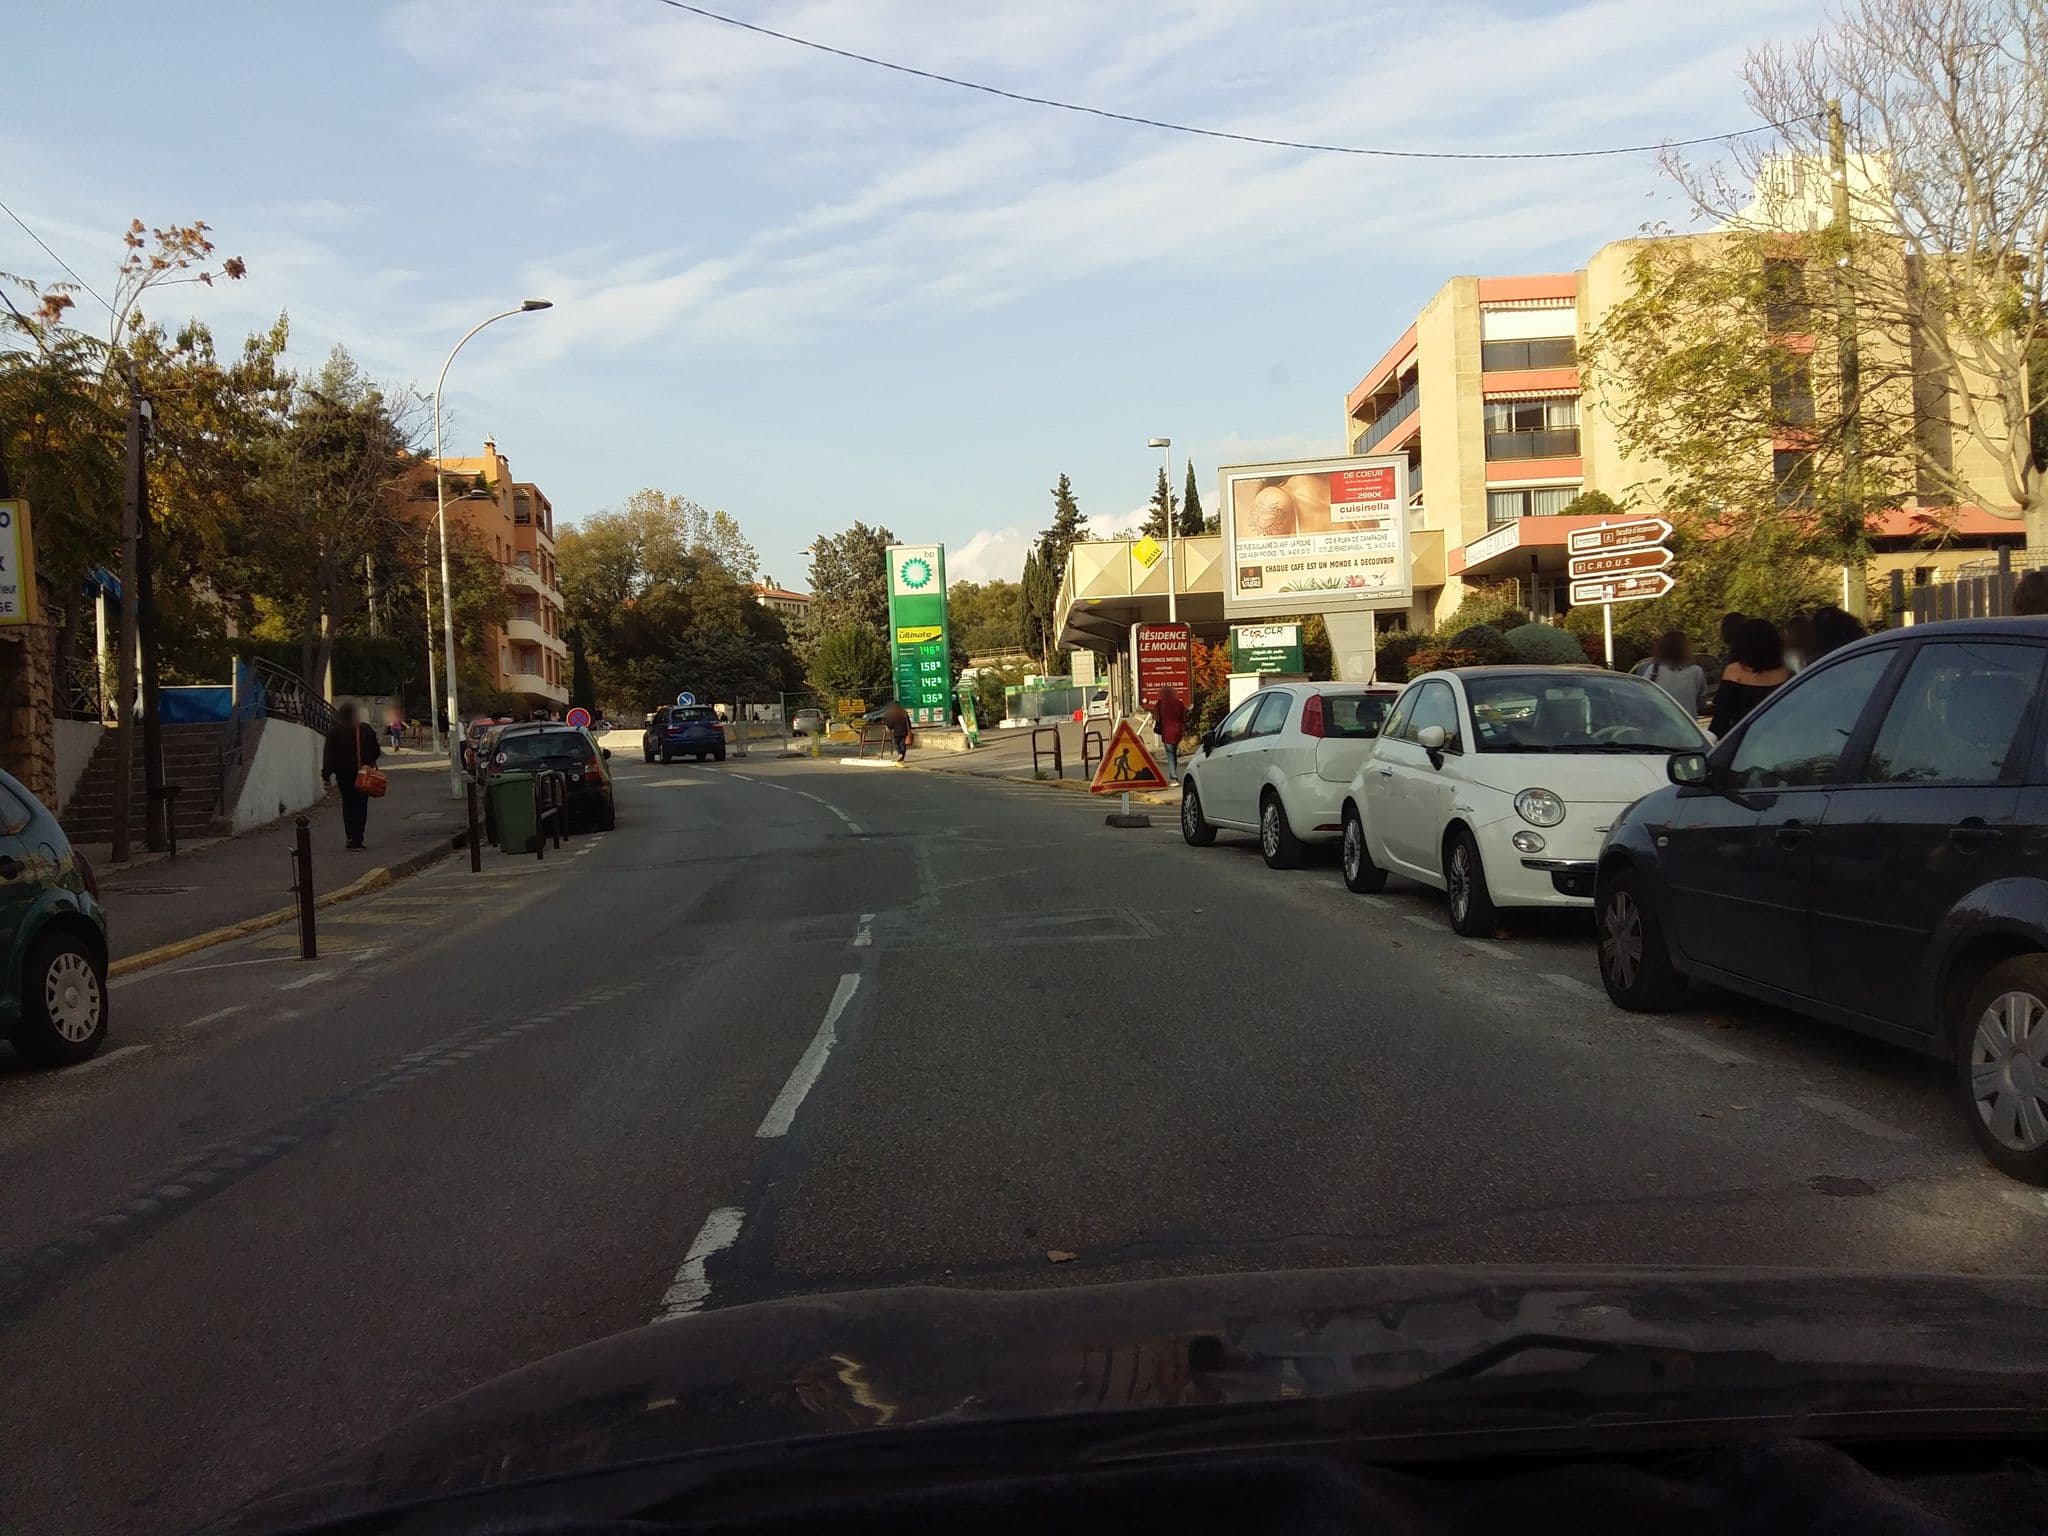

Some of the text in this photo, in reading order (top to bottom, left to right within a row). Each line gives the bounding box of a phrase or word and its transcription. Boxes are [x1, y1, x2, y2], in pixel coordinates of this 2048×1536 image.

[1343, 469, 1383, 479] DE COEUR
[1340, 502, 1389, 513] cuisinella
[924, 551, 934, 559] bp
[1144, 548, 1160, 566] PRESSE
[1265, 564, 1288, 573] CHAQUE
[1307, 562, 1317, 570] EST
[1318, 561, 1327, 569] UN
[1329, 559, 1351, 568] MONDE
[1139, 630, 1187, 640] RÉSIDENCE
[1264, 626, 1283, 635] CLR
[1139, 642, 1187, 651] LE MOULIN
